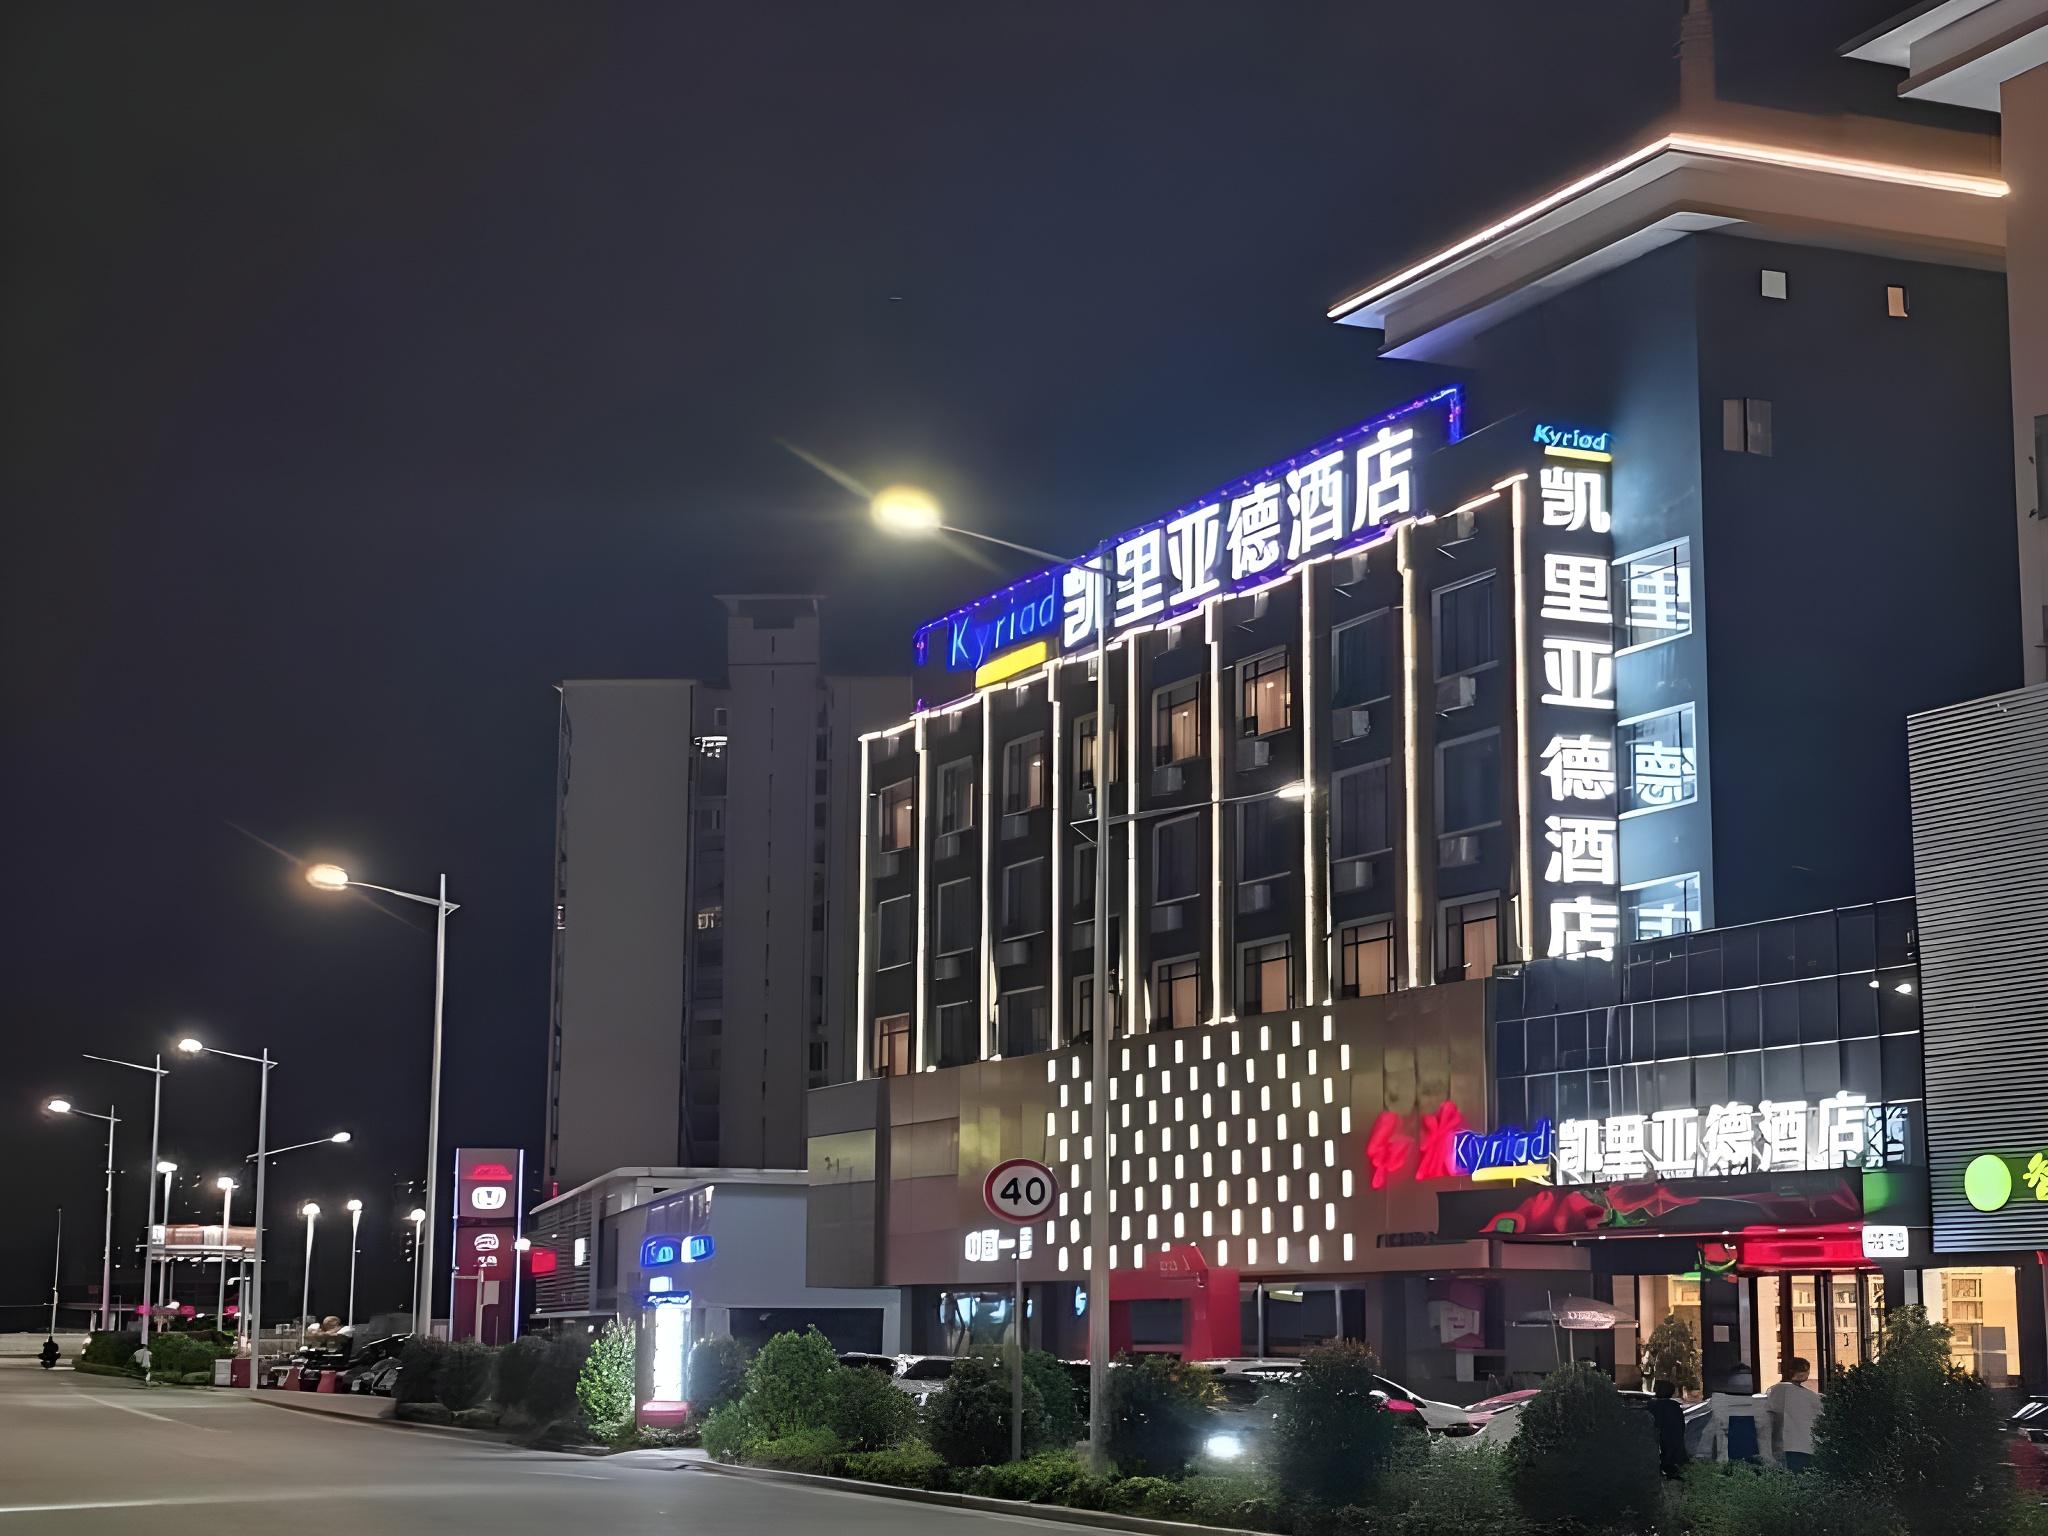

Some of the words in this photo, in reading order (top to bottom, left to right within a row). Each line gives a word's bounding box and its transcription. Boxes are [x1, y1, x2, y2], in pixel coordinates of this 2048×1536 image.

[1534, 424, 1608, 450] Kyriad
[1063, 427, 1413, 647] 凯里亚德酒店
[951, 576, 1056, 668] Kyriad
[1541, 467, 1619, 961] 凯里亚德酒店
[1454, 1119, 1552, 1174] Kyriad
[1559, 1091, 1866, 1180] 凯里亚德酒店
[1000, 1177, 1046, 1206] 40
